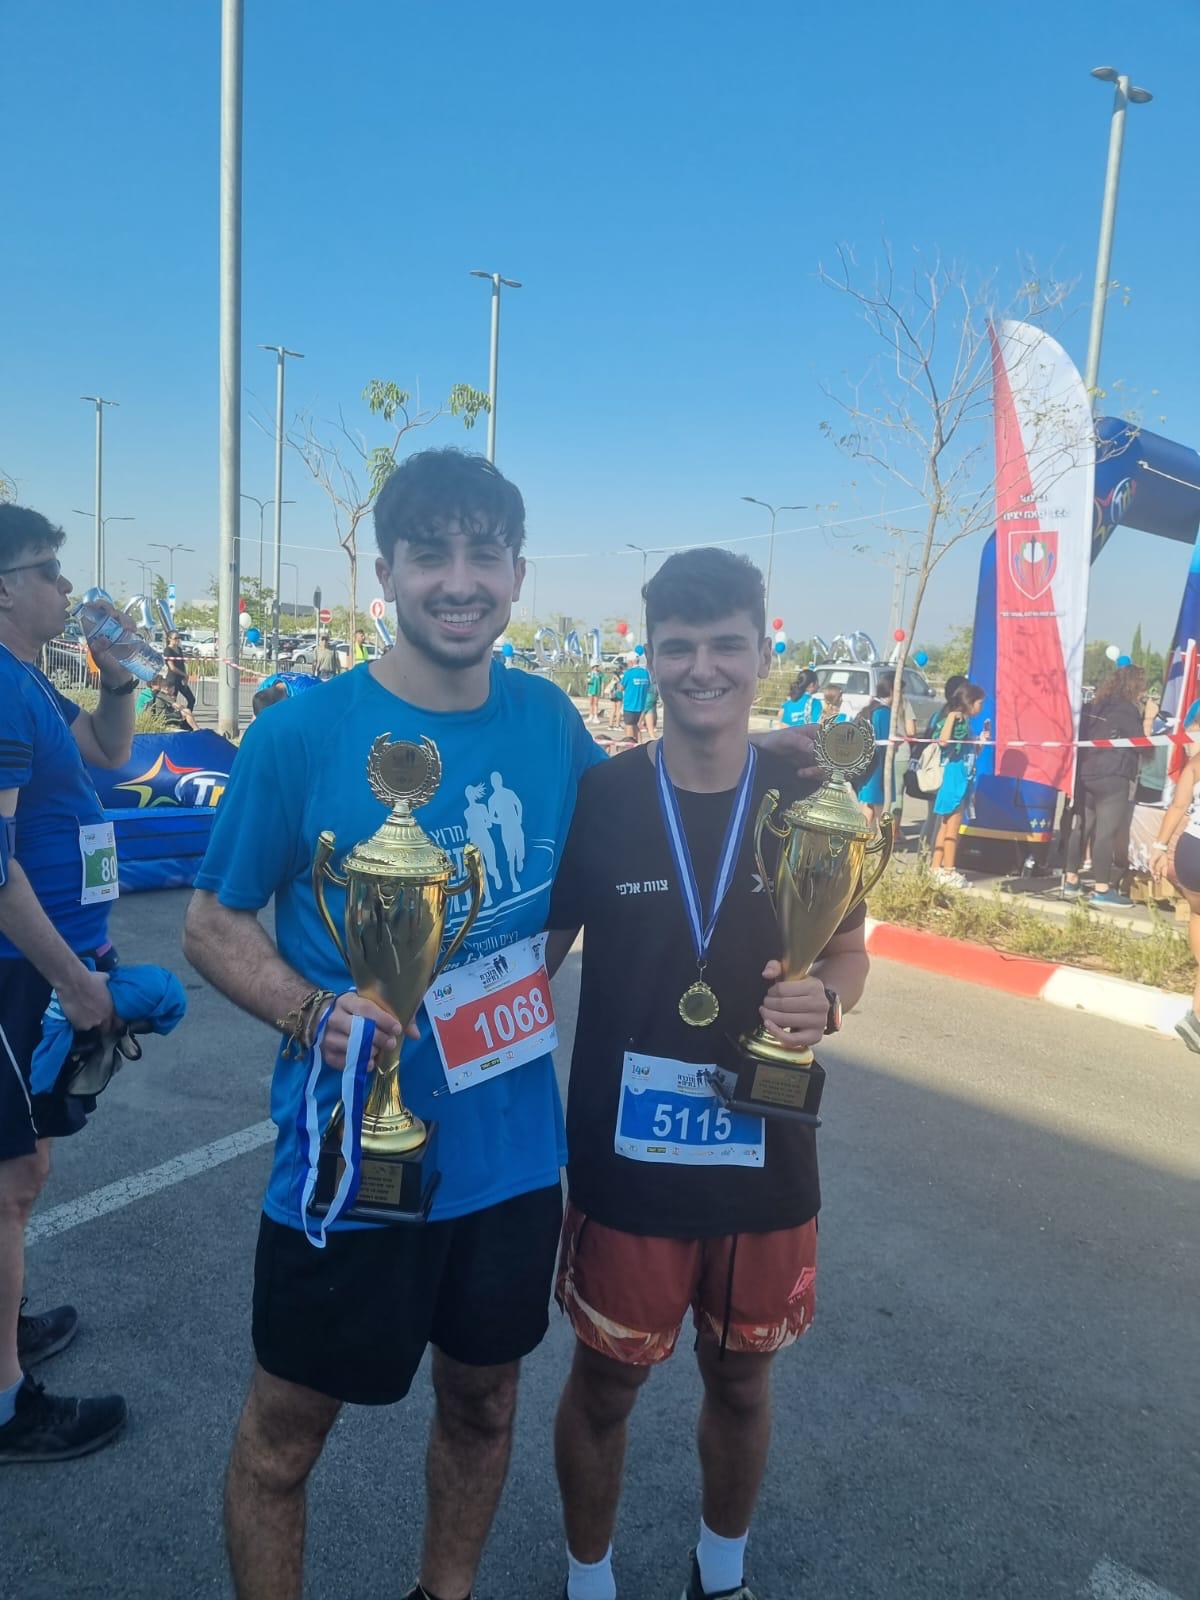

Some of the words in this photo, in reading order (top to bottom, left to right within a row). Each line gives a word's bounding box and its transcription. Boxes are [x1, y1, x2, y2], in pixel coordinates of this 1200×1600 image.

[193, 778, 225, 807] Tr
[430, 825, 465, 845] מרוץ
[615, 882, 641, 895] אלפי
[643, 879, 669, 892] צוות
[474, 987, 548, 1049] 1068
[652, 1103, 732, 1141] 5115
